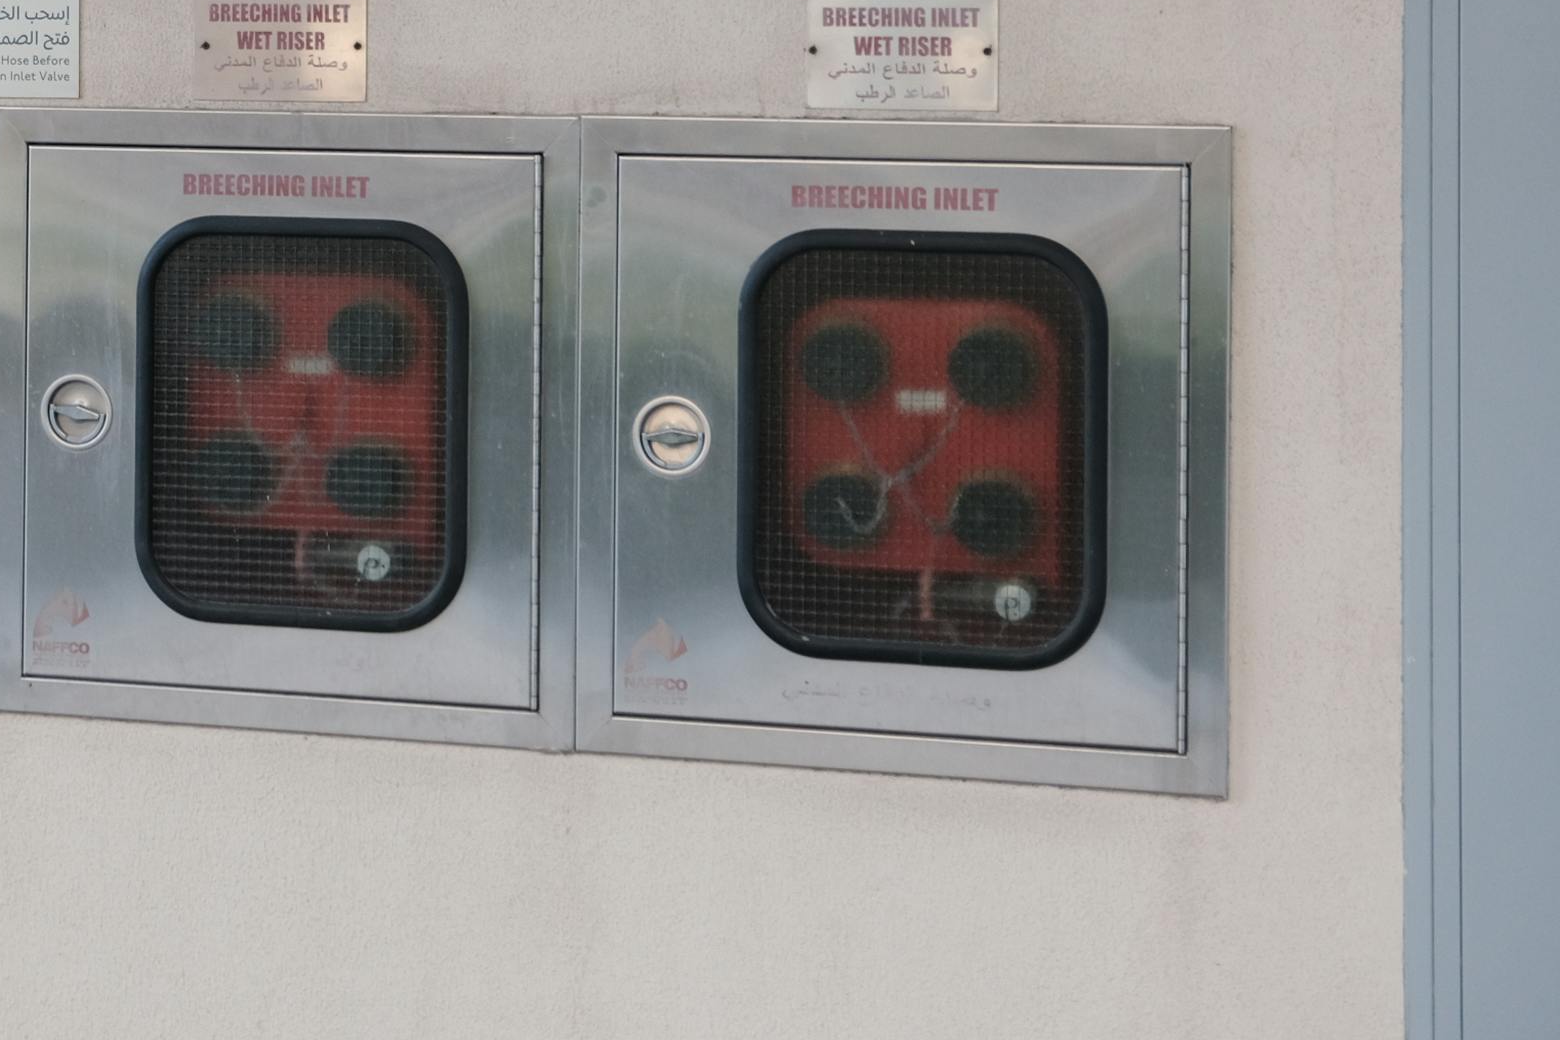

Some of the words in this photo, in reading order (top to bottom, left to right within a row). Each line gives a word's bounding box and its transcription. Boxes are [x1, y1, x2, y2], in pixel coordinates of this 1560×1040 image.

[24, 6, 70, 25] إسحب
[208, 3, 302, 23] BREECHING
[307, 4, 351, 24] INLET
[822, 7, 926, 27] BREECHING
[931, 7, 981, 28] INLET
[43, 31, 70, 50] فتح
[236, 31, 272, 50] WET
[277, 31, 325, 51] RISER
[854, 36, 893, 56] WET
[898, 36, 953, 57] RISER
[1, 55, 29, 66] Hose
[33, 55, 70, 66] Before
[214, 55, 256, 71] المدني
[262, 55, 302, 72] الدفاع
[308, 54, 348, 71] وصلة
[10, 71, 36, 81] Inlet
[39, 71, 70, 82] Valve
[828, 62, 875, 79] المدني
[882, 62, 926, 80] الدفاع
[932, 62, 978, 79] وصلة
[856, 85, 896, 103] الرطب
[903, 86, 950, 100] الصاعد
[183, 173, 305, 197] BREECHING
[311, 175, 370, 198] INLET
[791, 185, 927, 210] BREECHING
[934, 187, 999, 211] INLET
